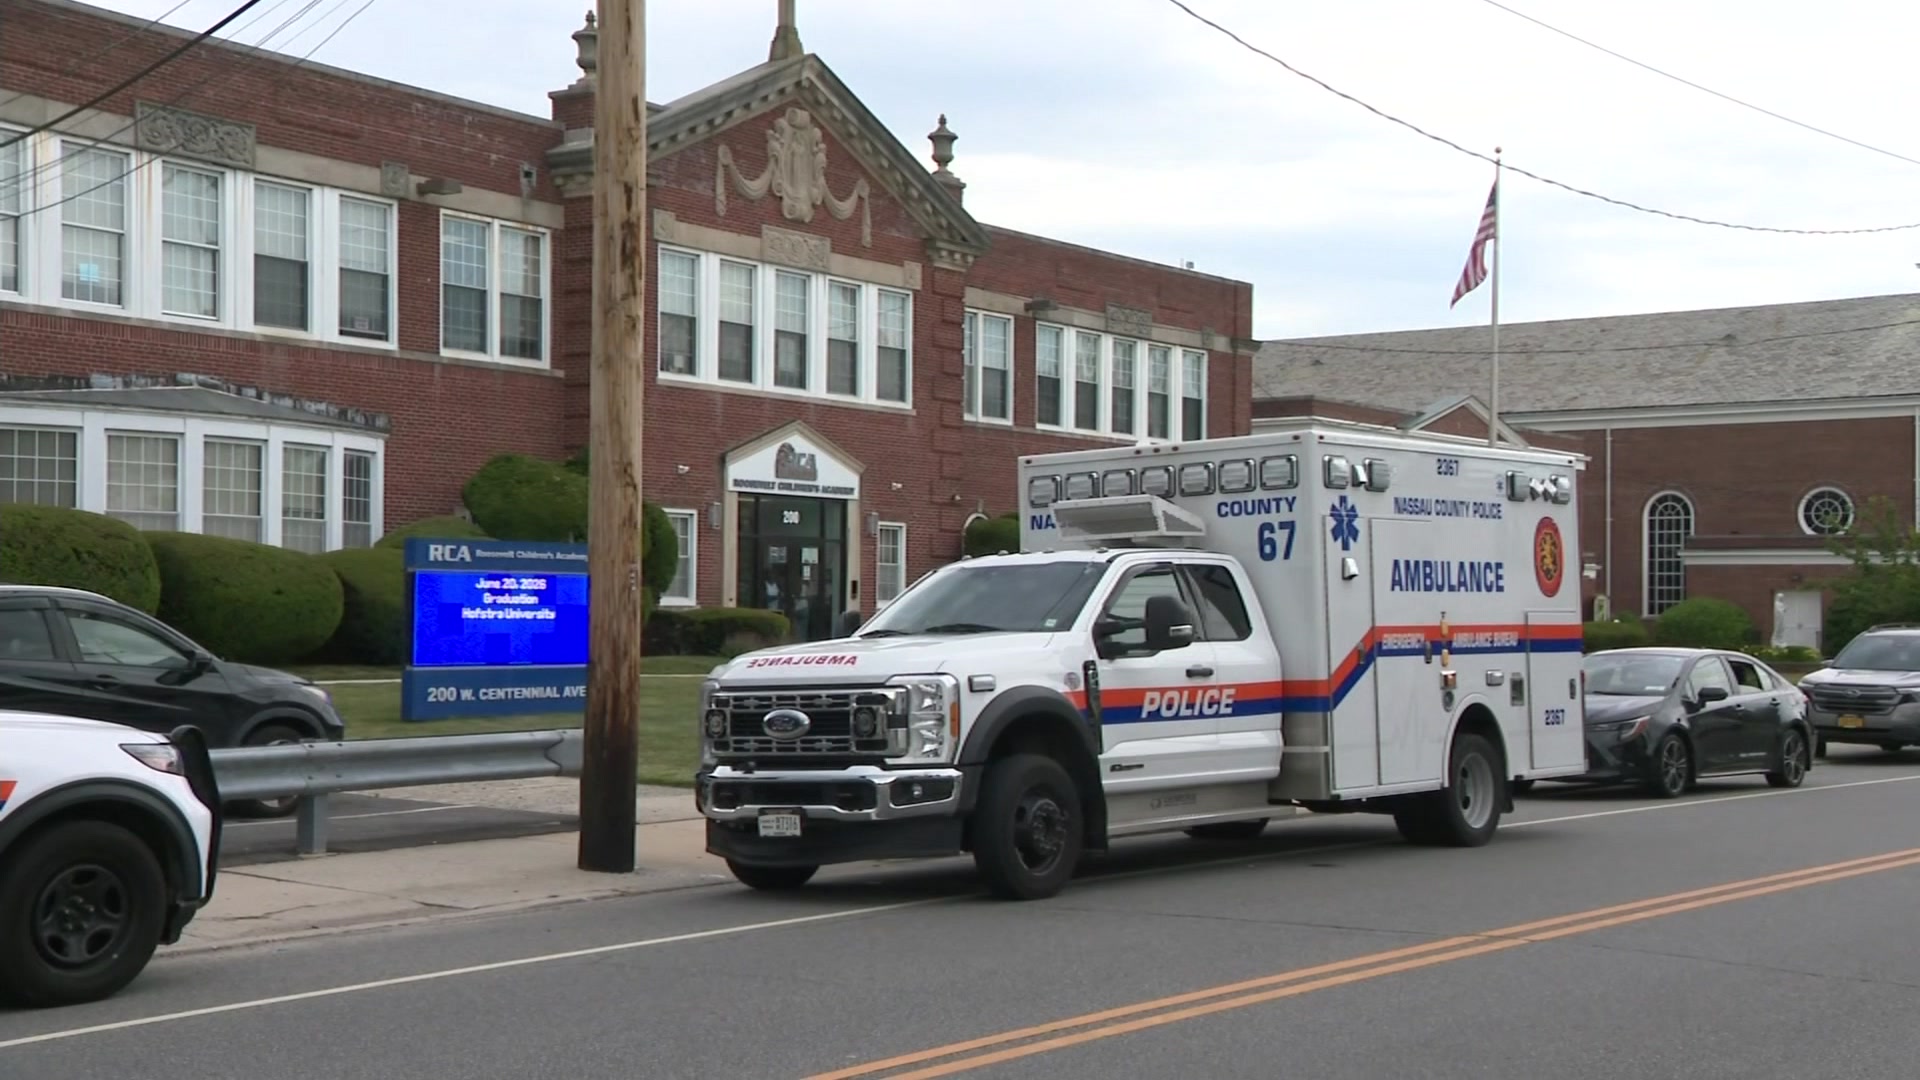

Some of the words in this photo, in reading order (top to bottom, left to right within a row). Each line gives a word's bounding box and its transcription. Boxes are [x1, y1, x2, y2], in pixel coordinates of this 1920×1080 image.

[1437, 458, 1459, 476] 2367
[1217, 497, 1297, 518] COUNTY
[1394, 497, 1432, 516] NASSAU
[1434, 499, 1470, 517] COUNTY
[1473, 502, 1502, 519] POLICE
[1258, 521, 1295, 561] 67
[428, 544, 472, 562] RCA
[475, 550, 515, 559] Roosevelt
[475, 577, 500, 589] June
[519, 578, 547, 590] 2026
[1391, 559, 1505, 592] AMBULANCE
[483, 592, 539, 604] Graduation
[461, 607, 504, 619] Hofstra
[504, 607, 556, 619] University
[427, 687, 457, 702] 200
[460, 689, 475, 700] W.
[479, 687, 560, 700] CENTENNIAL
[563, 686, 587, 697] AVE
[1140, 688, 1236, 719] POLICE
[1545, 709, 1565, 726] 2367
